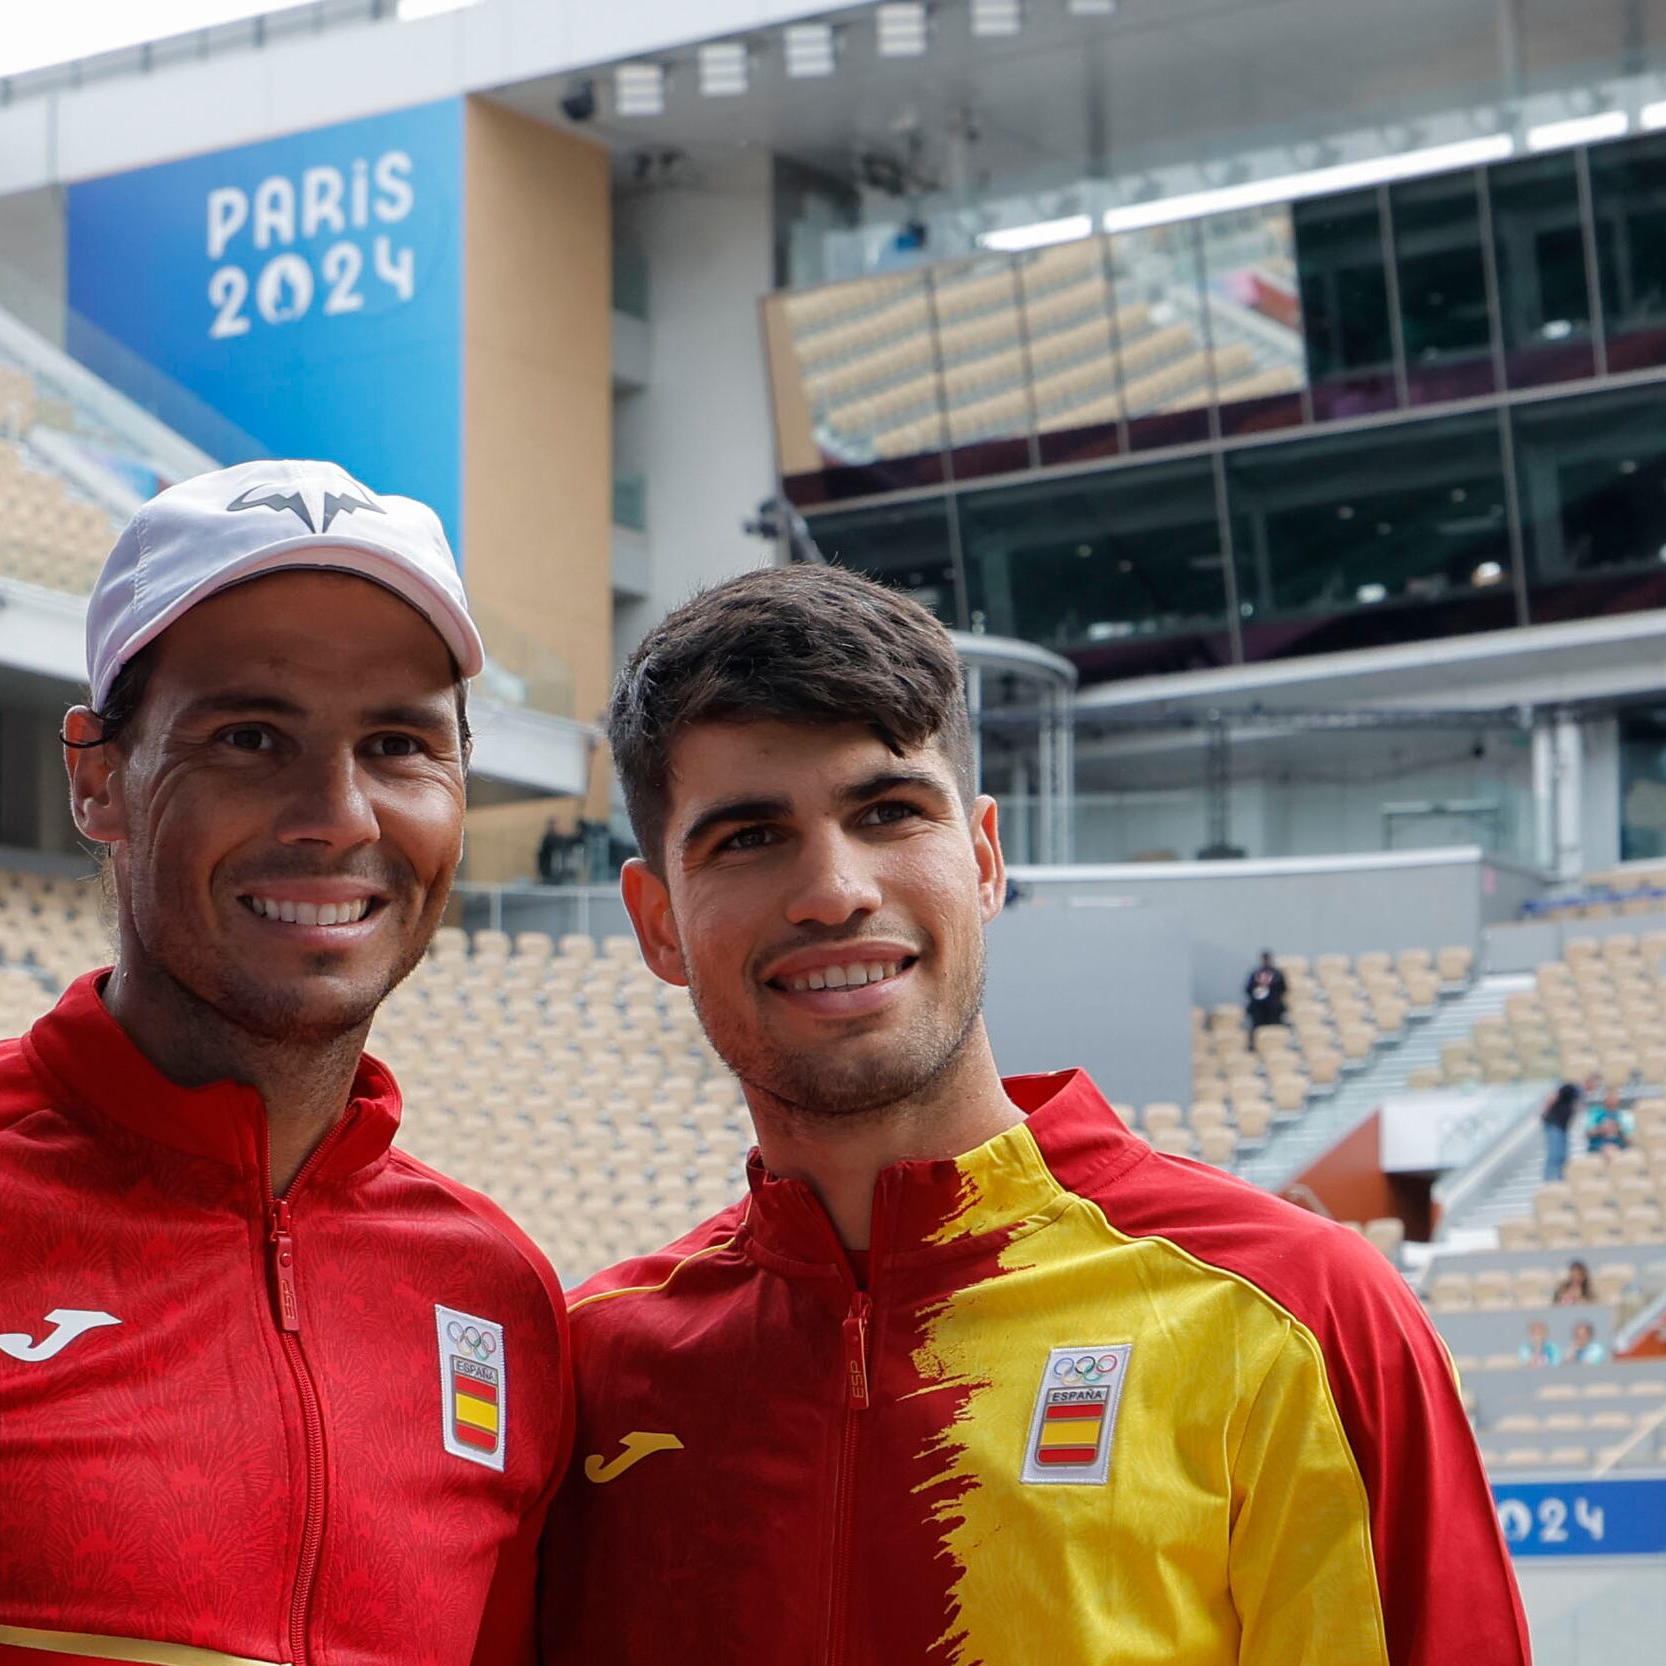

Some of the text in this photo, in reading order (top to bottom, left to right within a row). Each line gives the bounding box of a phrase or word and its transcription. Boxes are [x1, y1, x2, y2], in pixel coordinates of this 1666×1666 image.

[208, 234, 414, 339] 2024
[282, 1279, 297, 1319] ESP
[457, 1361, 495, 1381] ESPAÑA
[850, 1360, 864, 1398] ESP
[1052, 1388, 1102, 1402] ESPAÑA
[1497, 1497, 1605, 1544] 024
